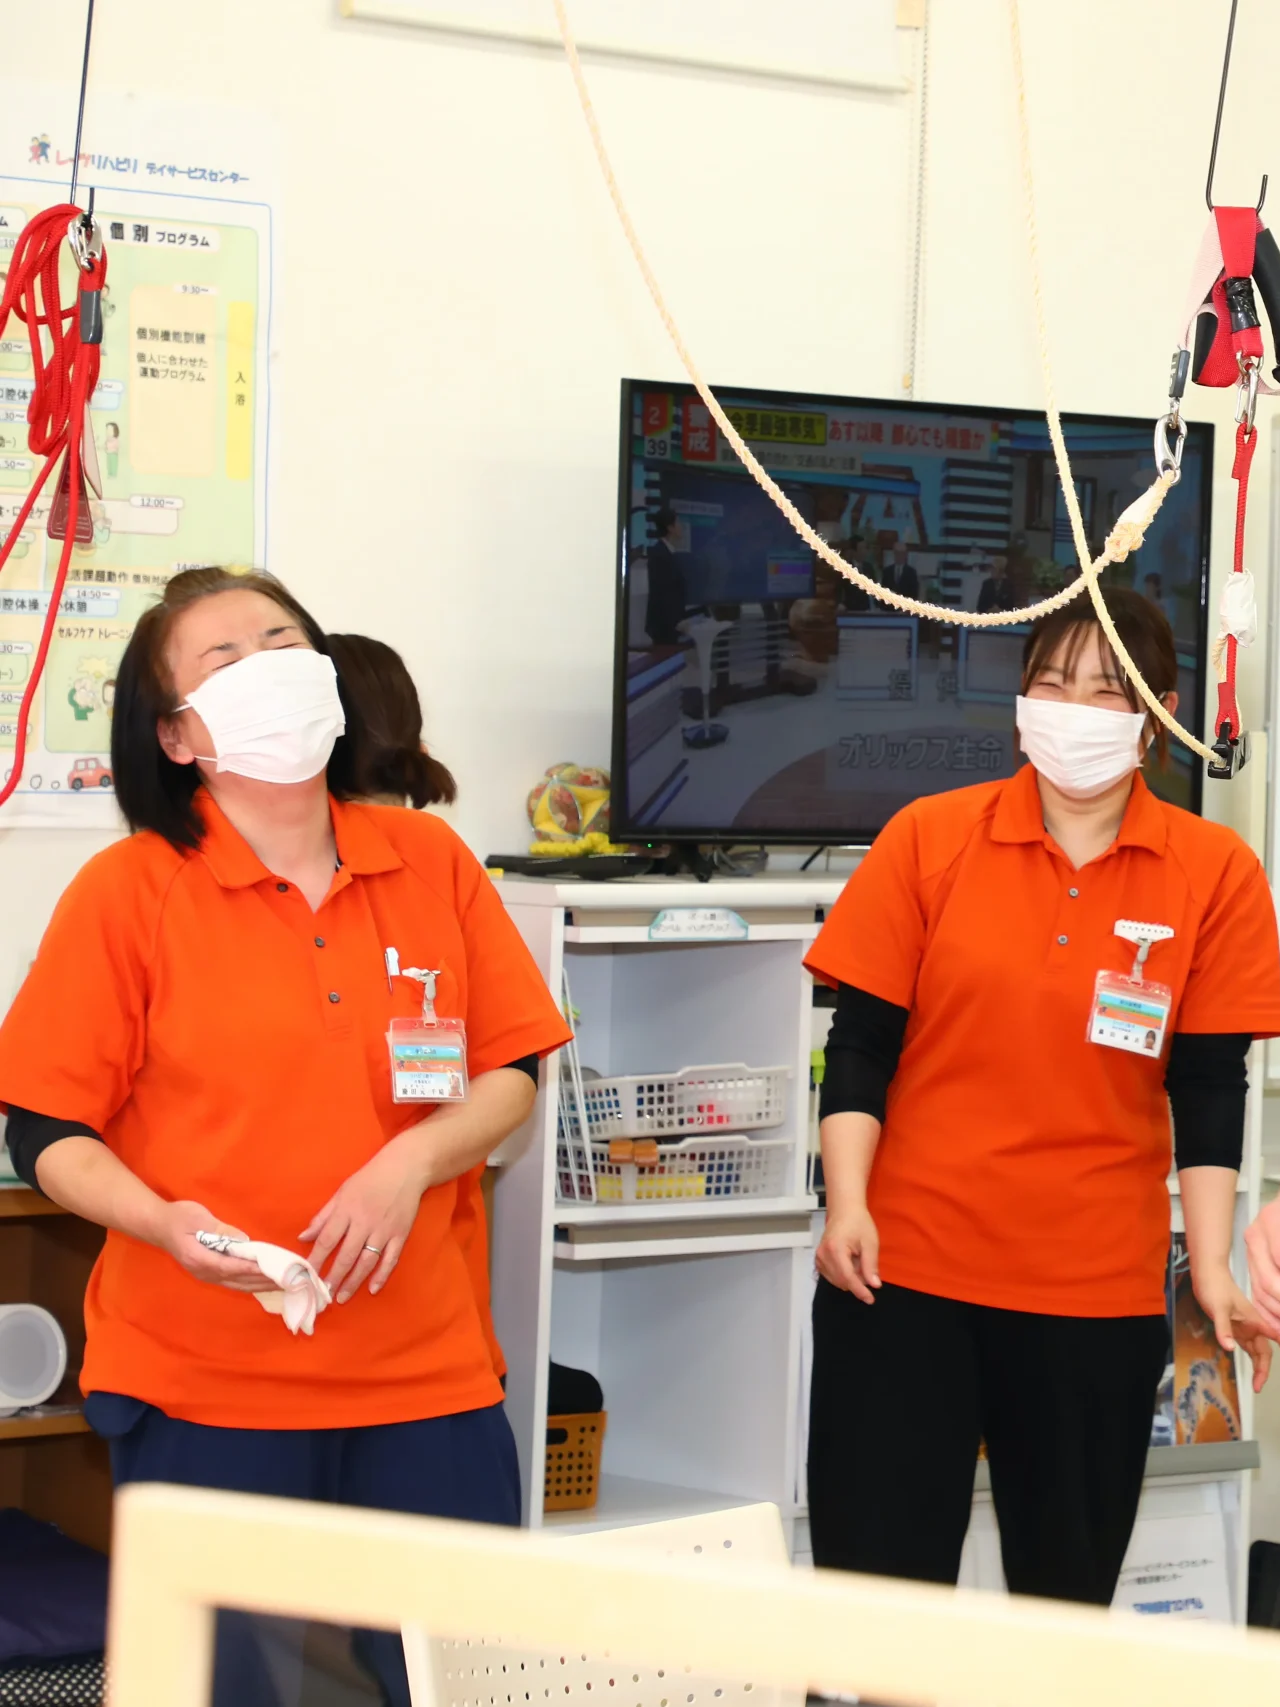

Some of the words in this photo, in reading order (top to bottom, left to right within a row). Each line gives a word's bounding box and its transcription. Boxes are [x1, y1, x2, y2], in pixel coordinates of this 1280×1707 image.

[145, 162, 250, 184] デイサービスセンター
[155, 230, 210, 247] プログラム
[646, 438, 668, 457] 39
[838, 733, 1005, 773] オリックス生命
